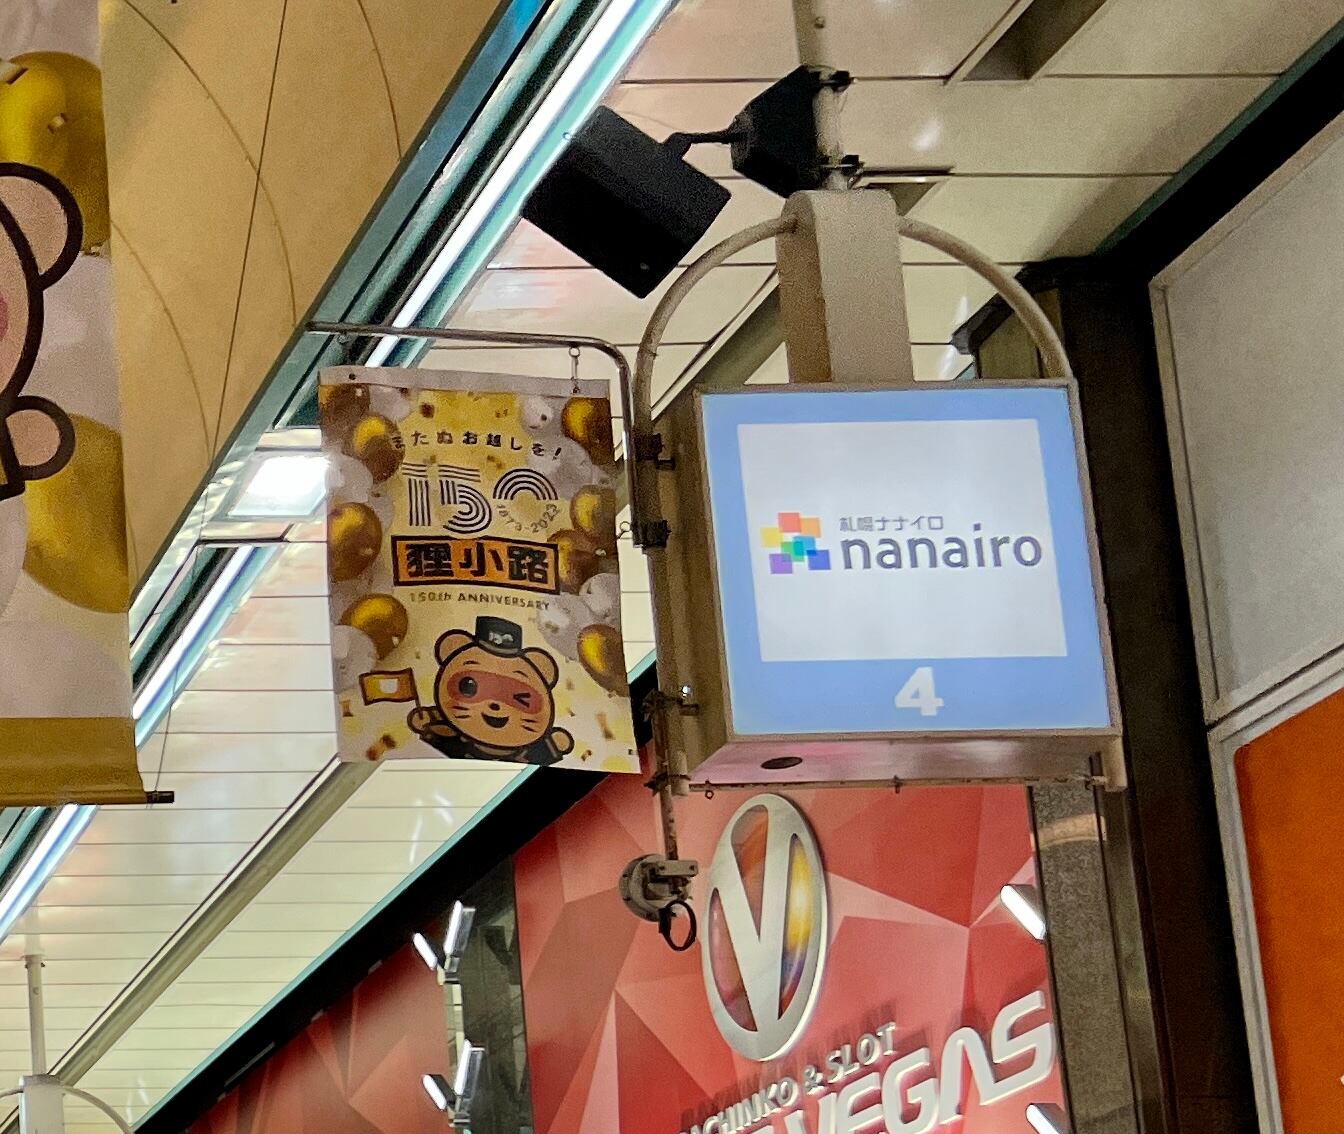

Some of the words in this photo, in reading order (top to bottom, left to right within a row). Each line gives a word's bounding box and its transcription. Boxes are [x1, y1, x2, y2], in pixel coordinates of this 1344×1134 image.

[839, 515, 945, 531] 札幌ナナイロ
[840, 522, 1044, 574] nanairo
[404, 541, 550, 583] 狸小路
[893, 667, 945, 717] 4
[824, 1021, 897, 1081] SLOT
